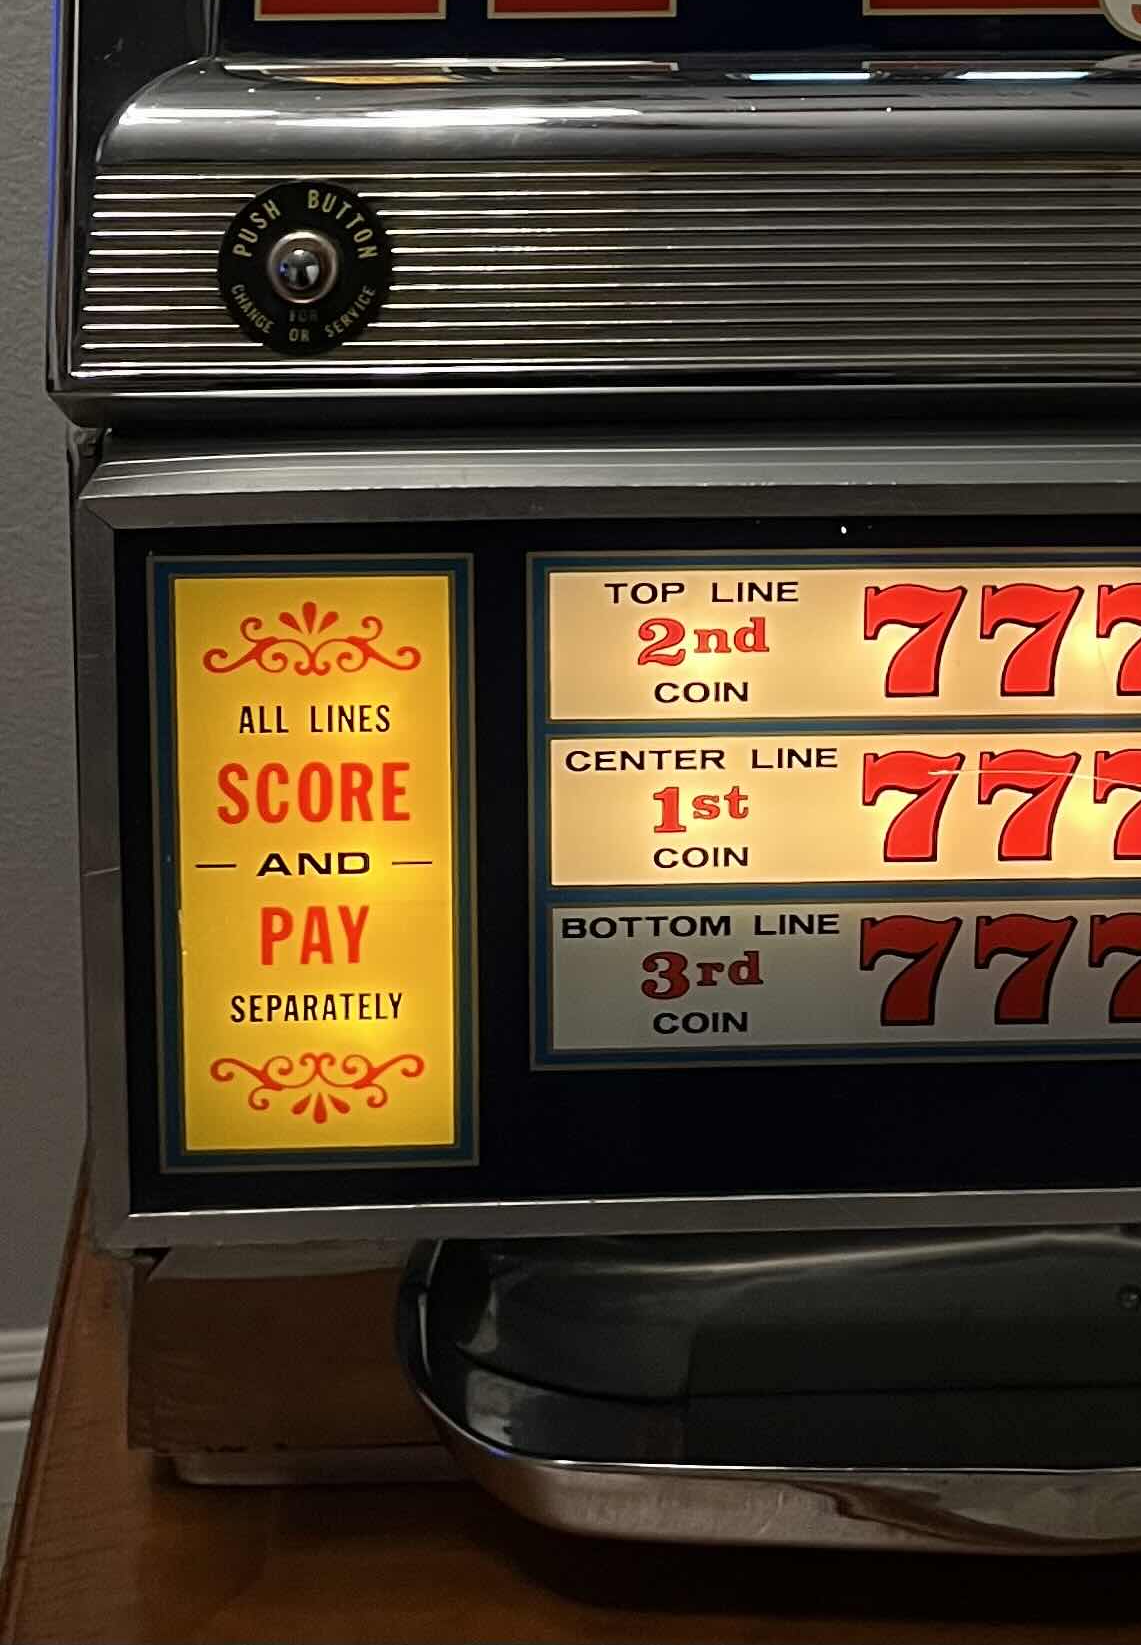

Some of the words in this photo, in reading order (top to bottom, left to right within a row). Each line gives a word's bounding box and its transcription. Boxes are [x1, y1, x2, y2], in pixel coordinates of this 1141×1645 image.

[232, 199, 281, 258] PUSH
[307, 189, 379, 260] BUTTON
[231, 284, 276, 335] CHANGE
[288, 328, 310, 342] OR
[324, 285, 376, 339] SERVICE
[605, 582, 685, 604] TOP
[711, 581, 799, 602] LINE
[637, 616, 770, 666] 2nd
[653, 682, 749, 703] COIN
[239, 705, 289, 734] ALL
[310, 705, 391, 733] LINES
[565, 750, 725, 772] CENTER
[750, 748, 838, 769] LINE
[217, 761, 412, 825] SCORE
[652, 786, 750, 833] 1st
[256, 852, 371, 877] AND
[652, 847, 749, 869] COIN
[260, 905, 370, 966] PAY
[561, 917, 732, 939] BOTTOM
[754, 914, 841, 936] LINE
[641, 951, 764, 1000] 3rd
[230, 992, 403, 1024] SEPARATELY
[652, 1012, 749, 1033] COIN
